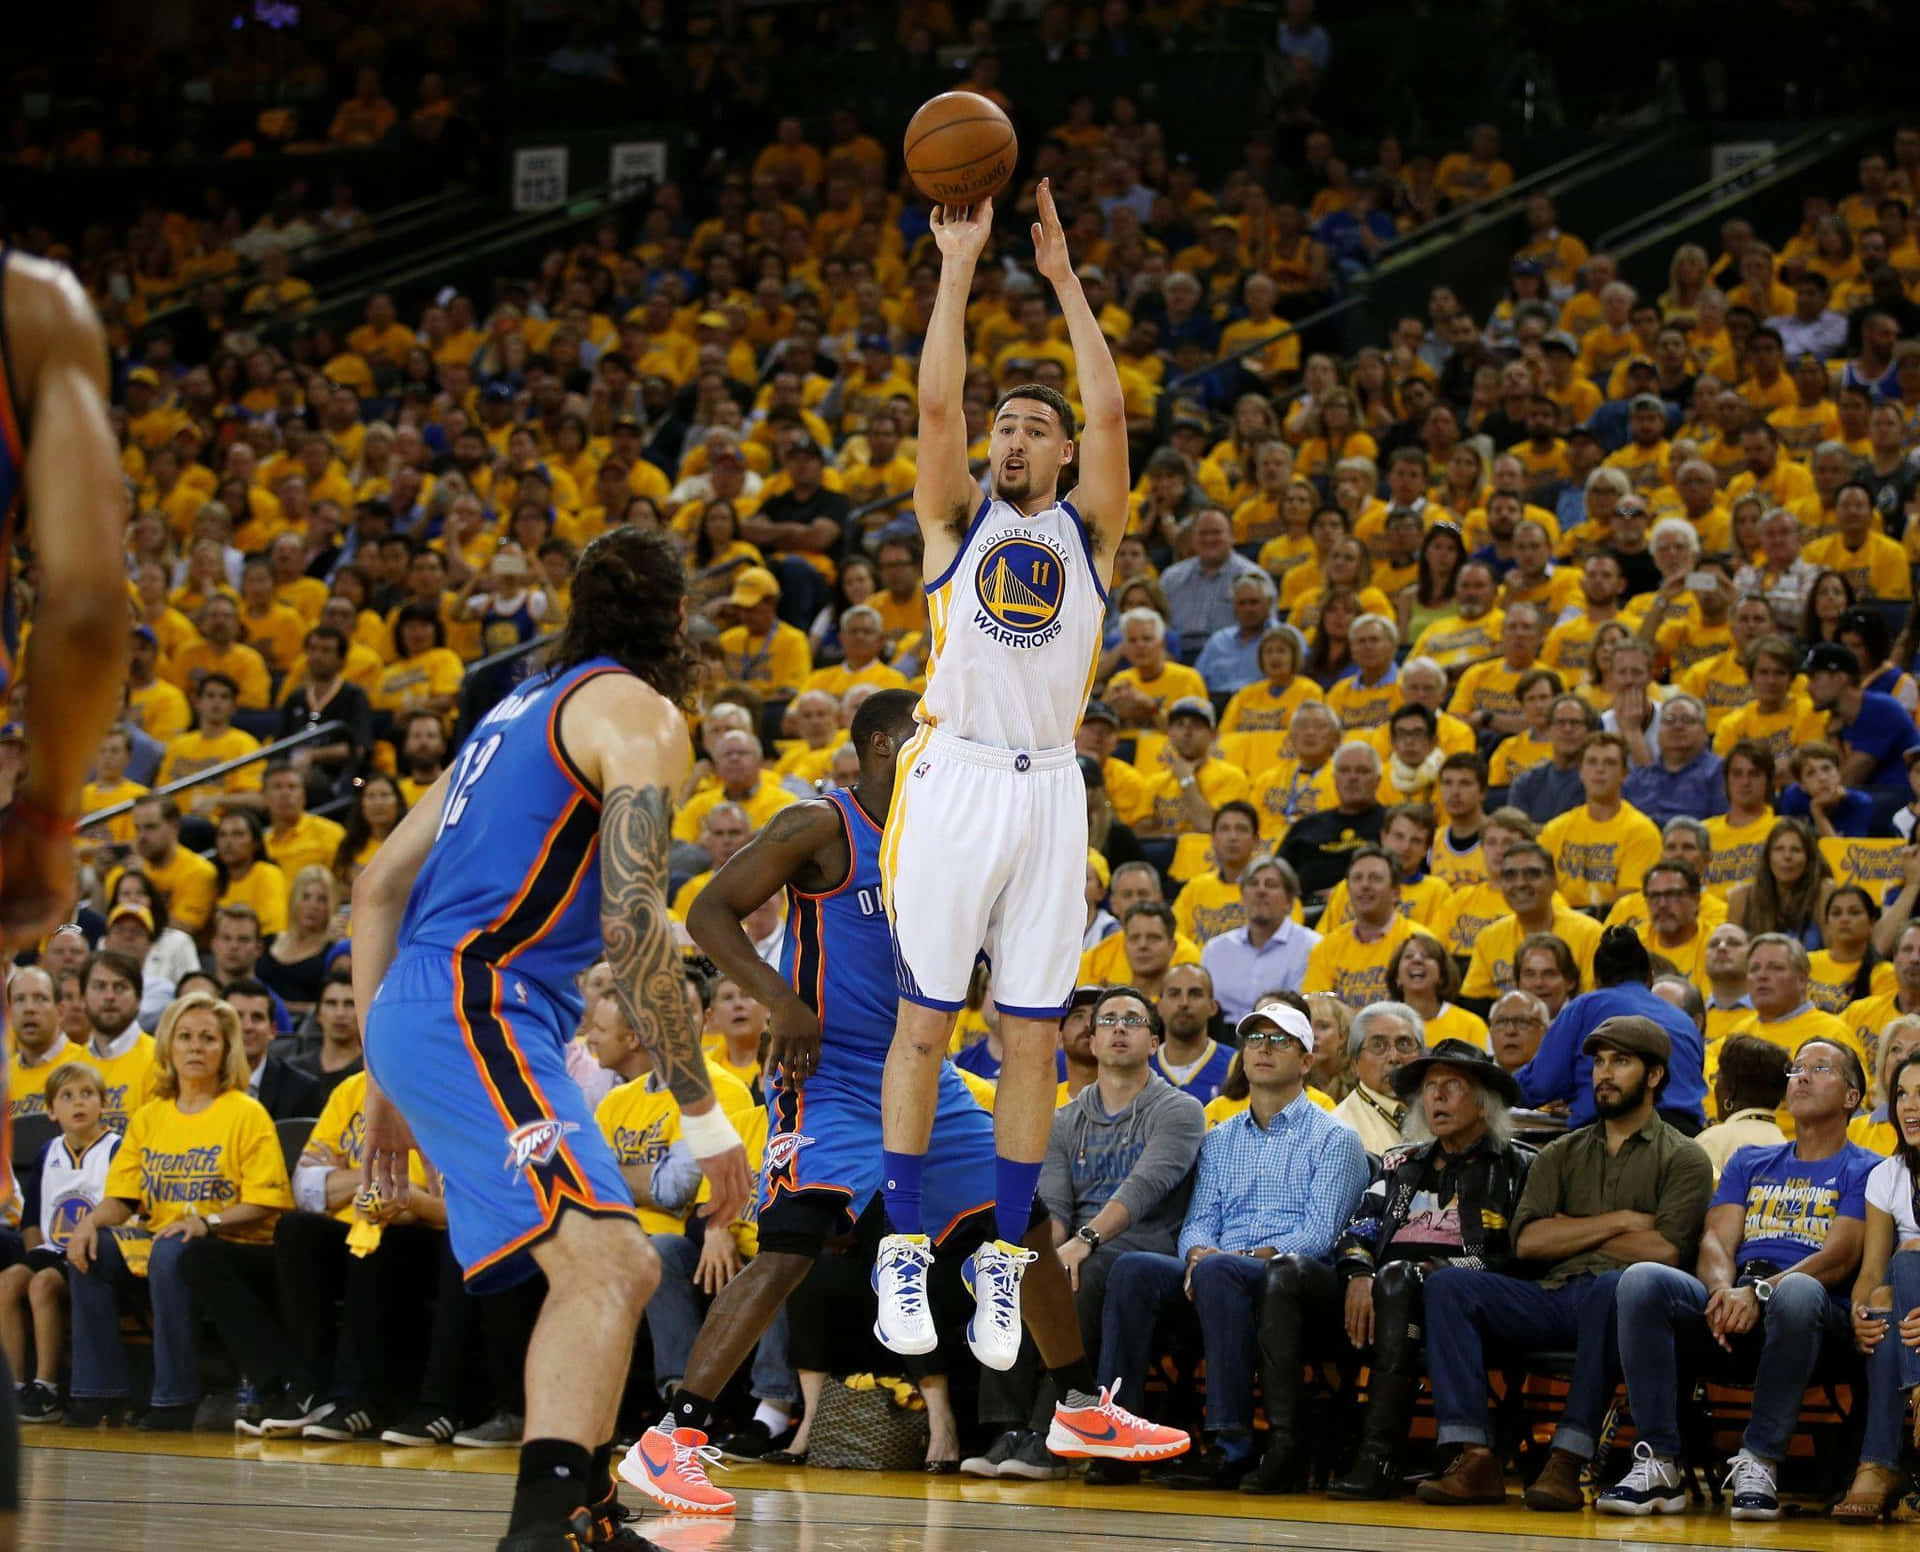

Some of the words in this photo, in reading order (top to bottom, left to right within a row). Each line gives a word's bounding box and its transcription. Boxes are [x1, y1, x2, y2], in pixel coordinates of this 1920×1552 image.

[978, 528, 1032, 553] GOLDEN
[1037, 533, 1071, 567] STATE
[1032, 560, 1050, 586] 11
[974, 609, 1062, 648] WARRIORS
[140, 1145, 222, 1180] Strength
[517, 1125, 551, 1166] OKC
[768, 1139, 793, 1166] OKC
